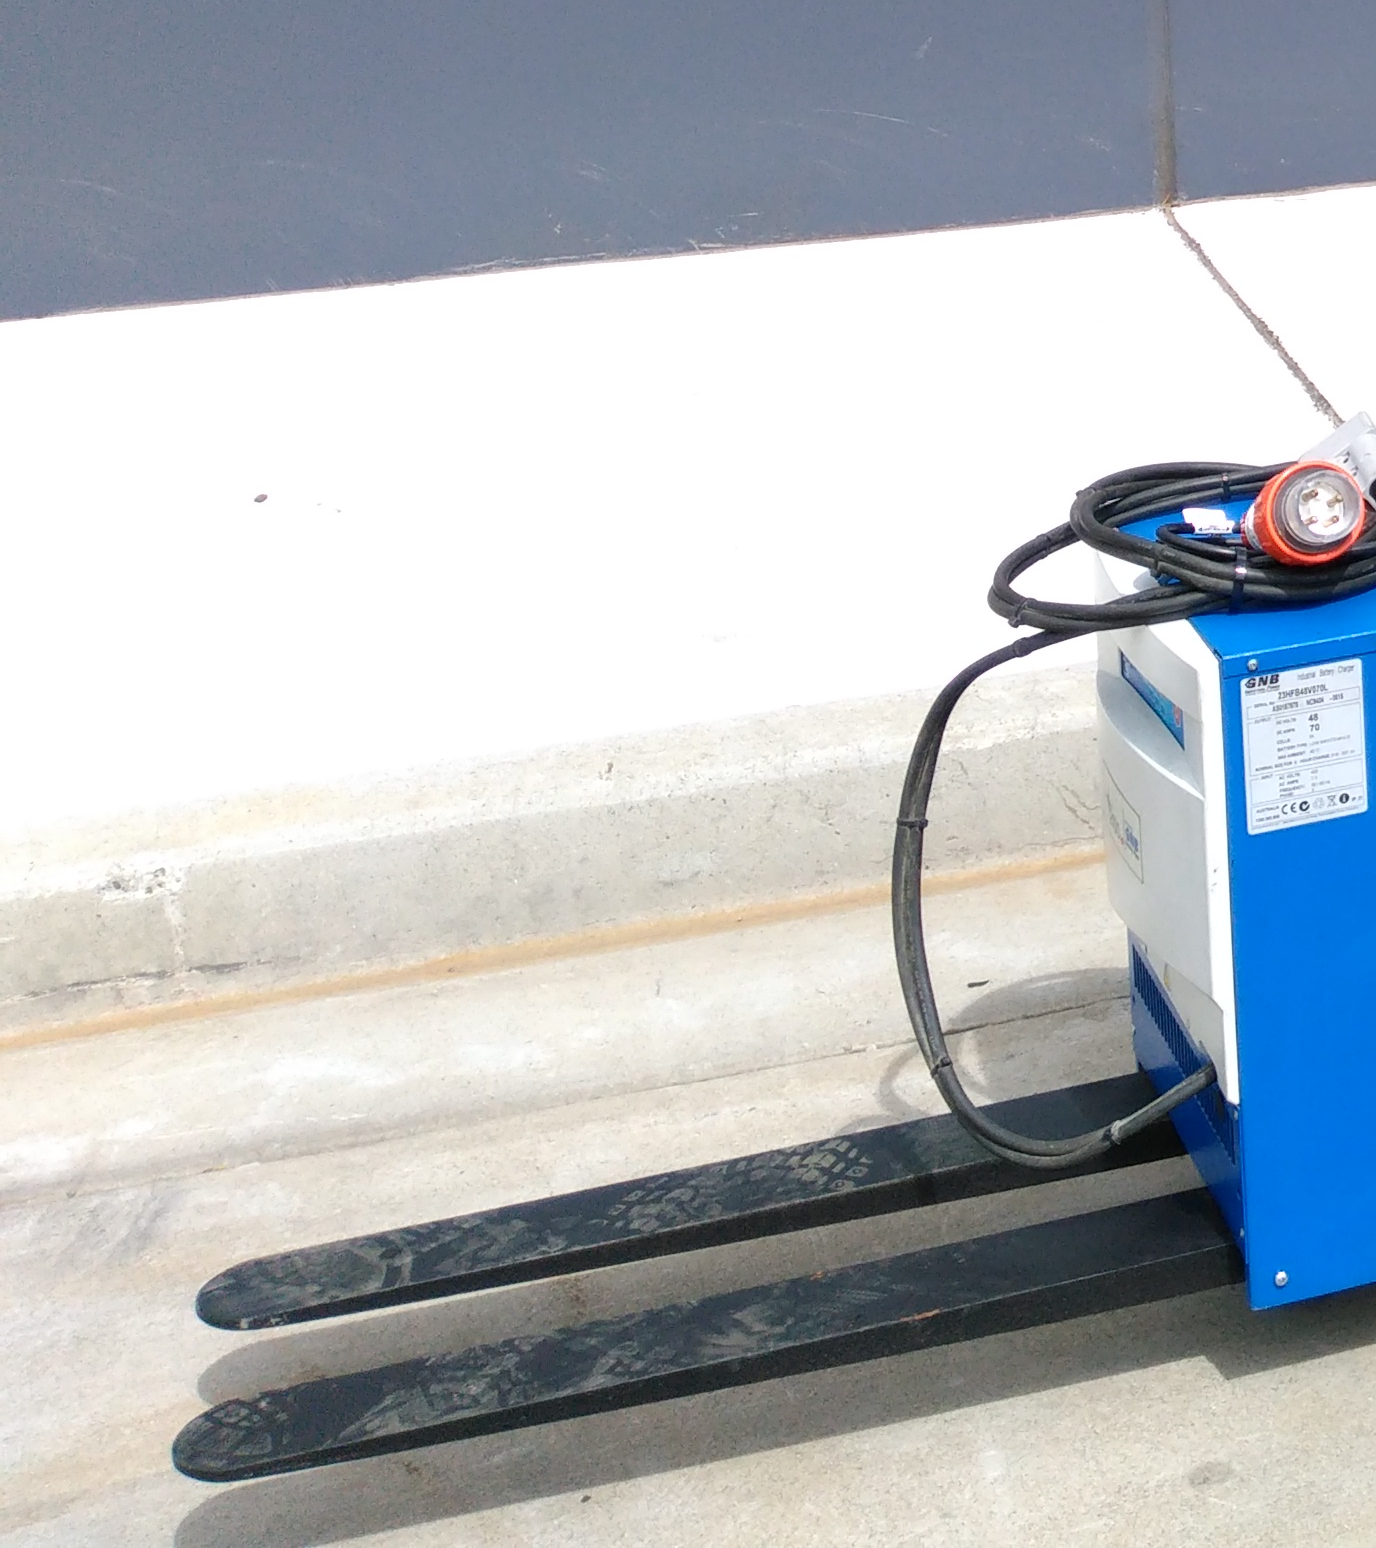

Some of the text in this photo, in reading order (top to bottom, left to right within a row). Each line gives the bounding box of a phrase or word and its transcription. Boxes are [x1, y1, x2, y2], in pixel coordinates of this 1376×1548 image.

[1244, 674, 1279, 688] GNB
[1308, 713, 1319, 722] 48
[1309, 723, 1320, 732] 70
